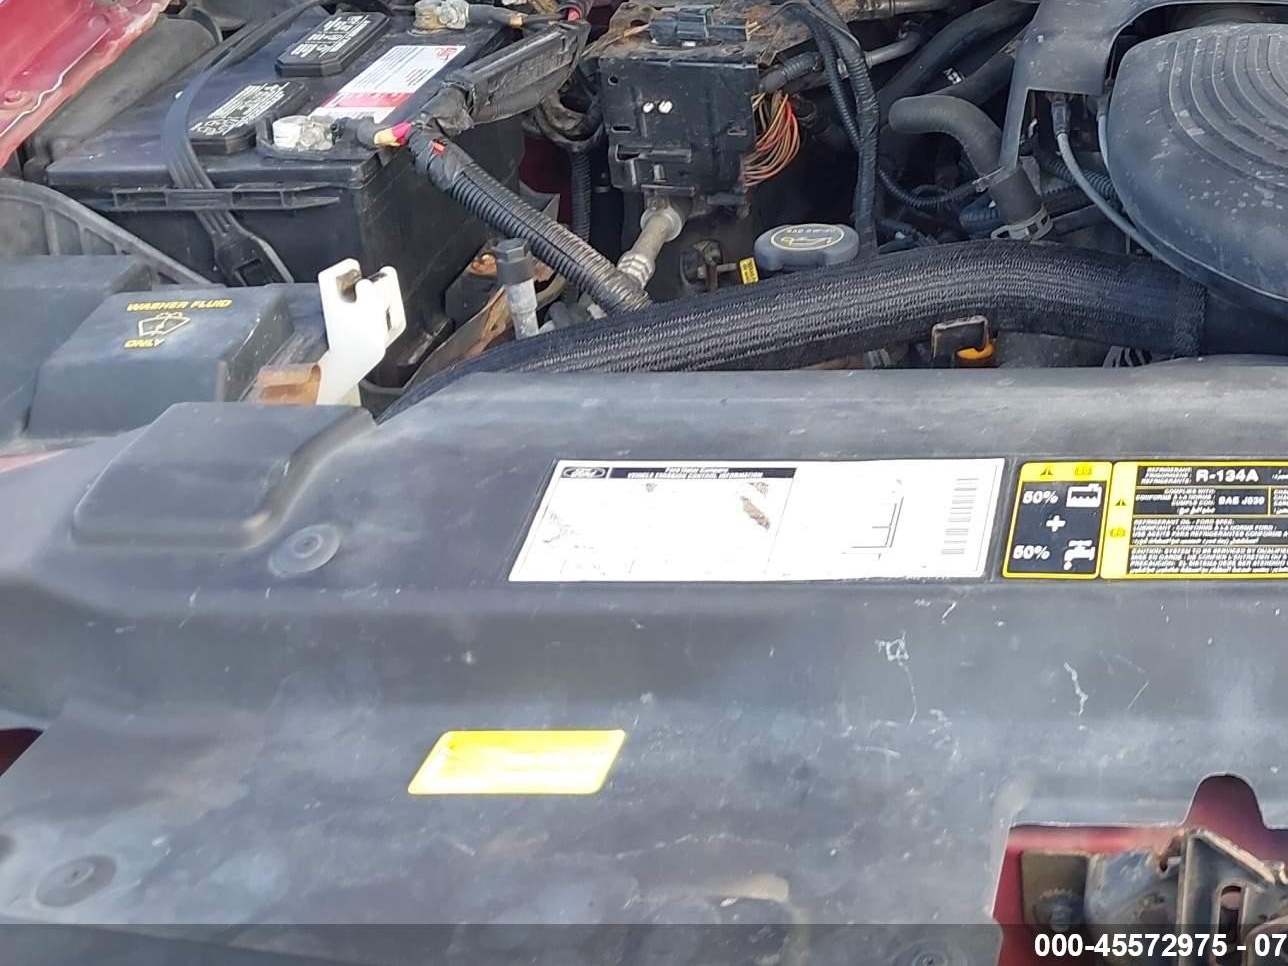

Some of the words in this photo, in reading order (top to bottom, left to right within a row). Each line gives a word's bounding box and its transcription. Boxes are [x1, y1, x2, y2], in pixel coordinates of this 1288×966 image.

[127, 301, 190, 312] WASHER
[190, 299, 233, 309] FLUID
[124, 338, 166, 348] ONLY
[1195, 468, 1260, 483] R-134A
[1022, 490, 1060, 504] 50%
[1218, 496, 1241, 506] SAE
[1012, 545, 1051, 560] 50%
